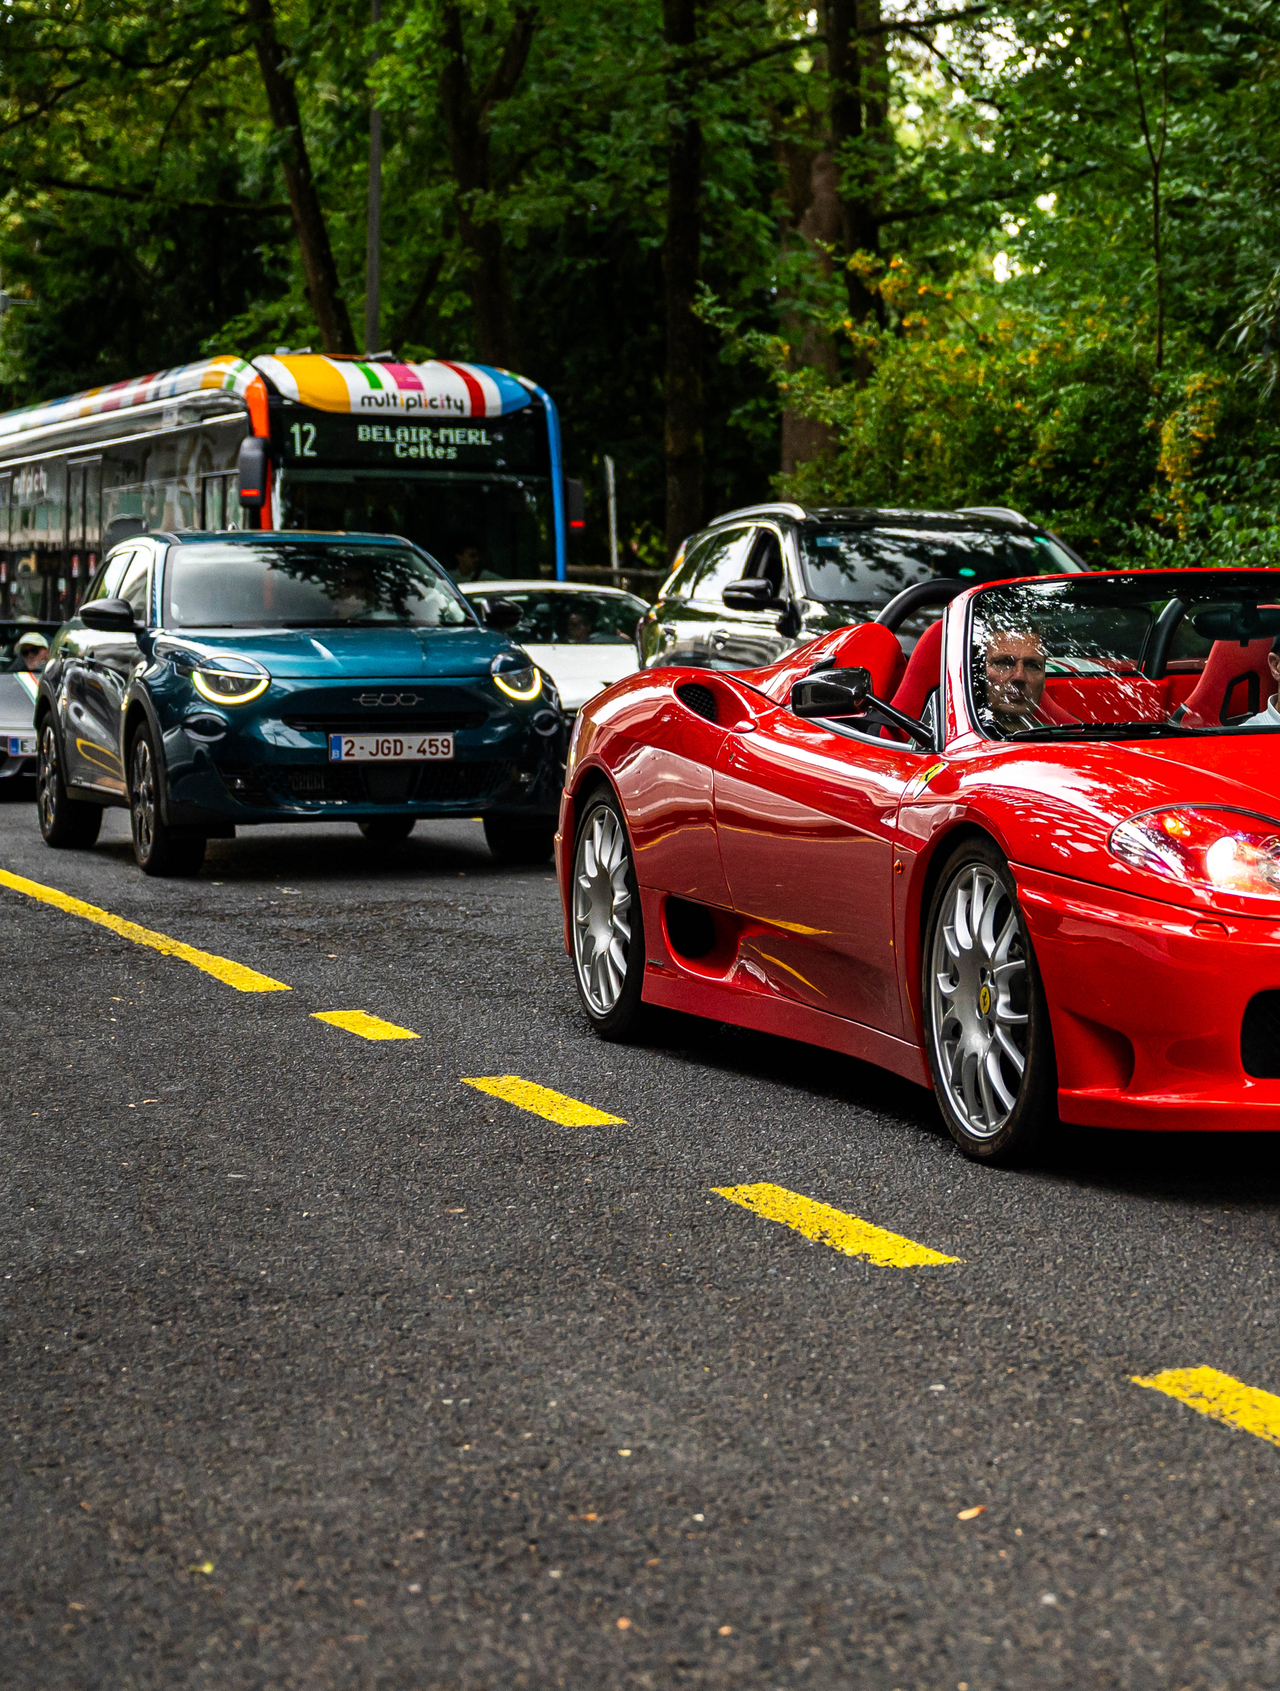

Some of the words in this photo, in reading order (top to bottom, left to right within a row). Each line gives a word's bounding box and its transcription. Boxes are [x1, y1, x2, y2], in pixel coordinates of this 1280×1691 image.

[361, 393, 465, 414] multiplicity
[290, 422, 318, 457] 12
[357, 425, 492, 445] BELAIR-MERL
[395, 443, 458, 459] Celtes
